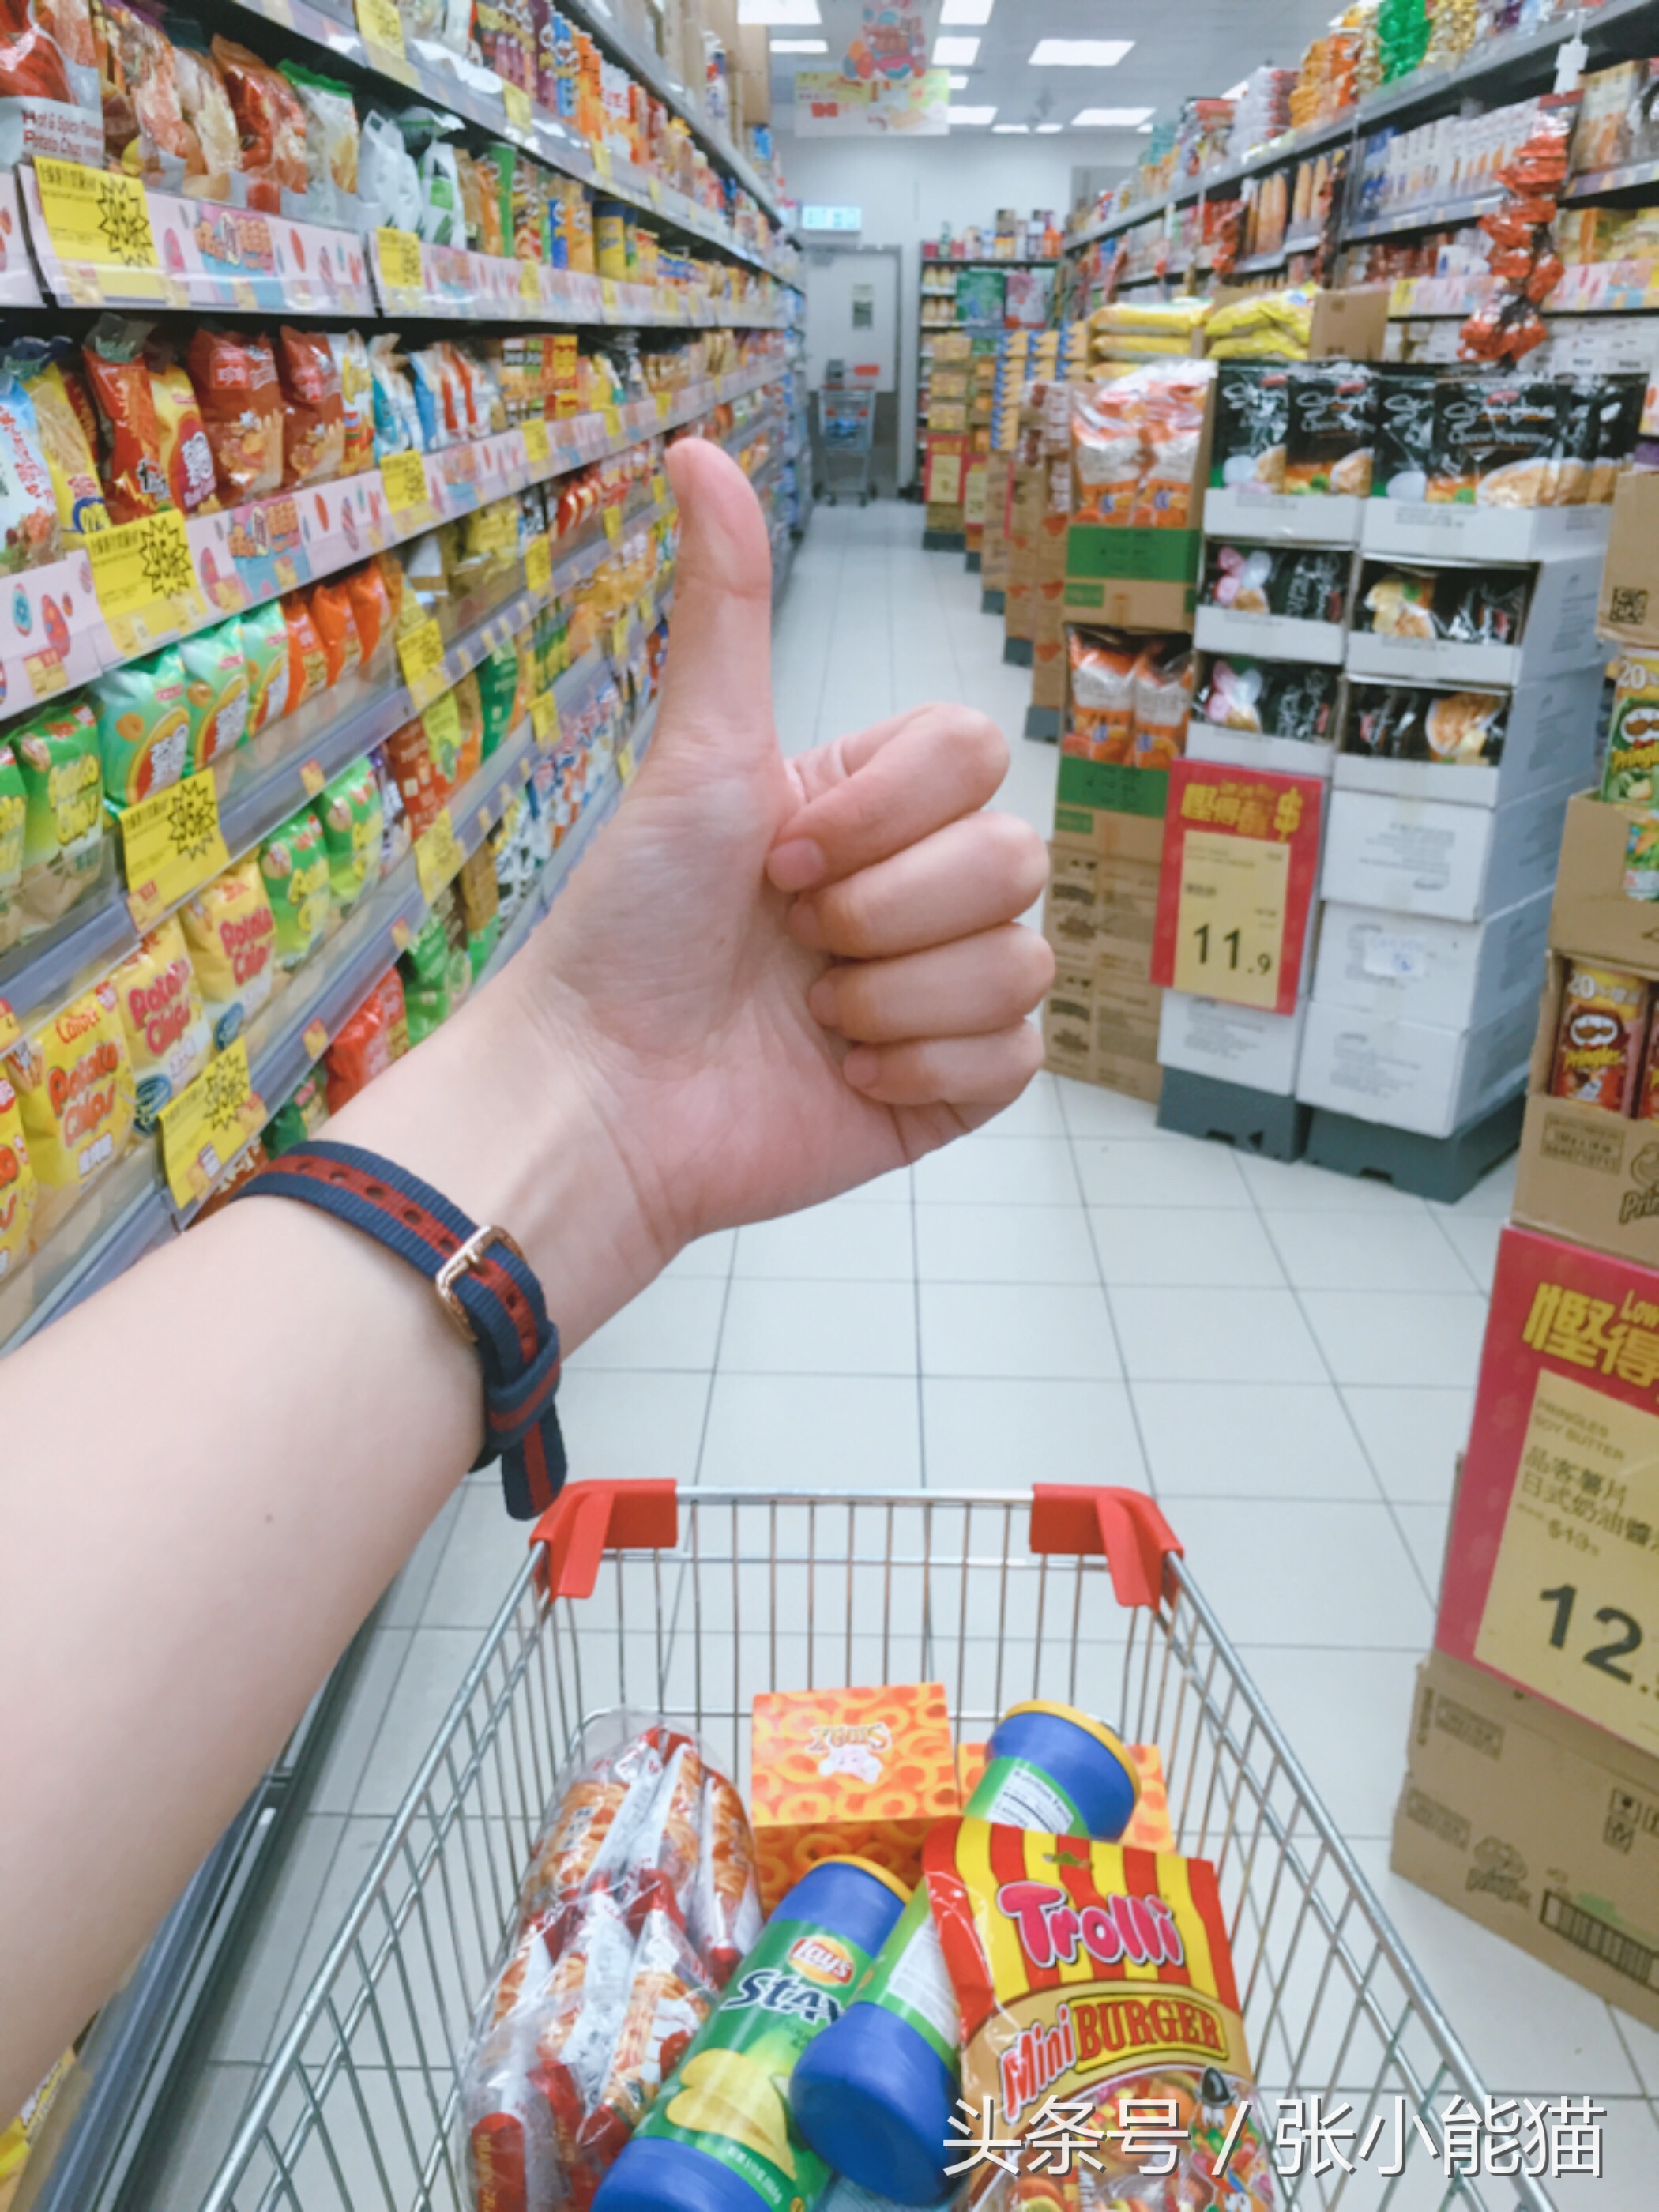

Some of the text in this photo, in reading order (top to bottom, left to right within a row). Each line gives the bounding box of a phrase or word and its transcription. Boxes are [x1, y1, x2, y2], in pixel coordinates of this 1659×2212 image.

[1194, 922, 1272, 976] 11.9
[47, 1040, 118, 1119] Potato
[1540, 1583, 1659, 1701] 12.
[996, 1879, 1183, 1969] Trolli
[999, 1998, 1224, 2127] Mini BURGER
